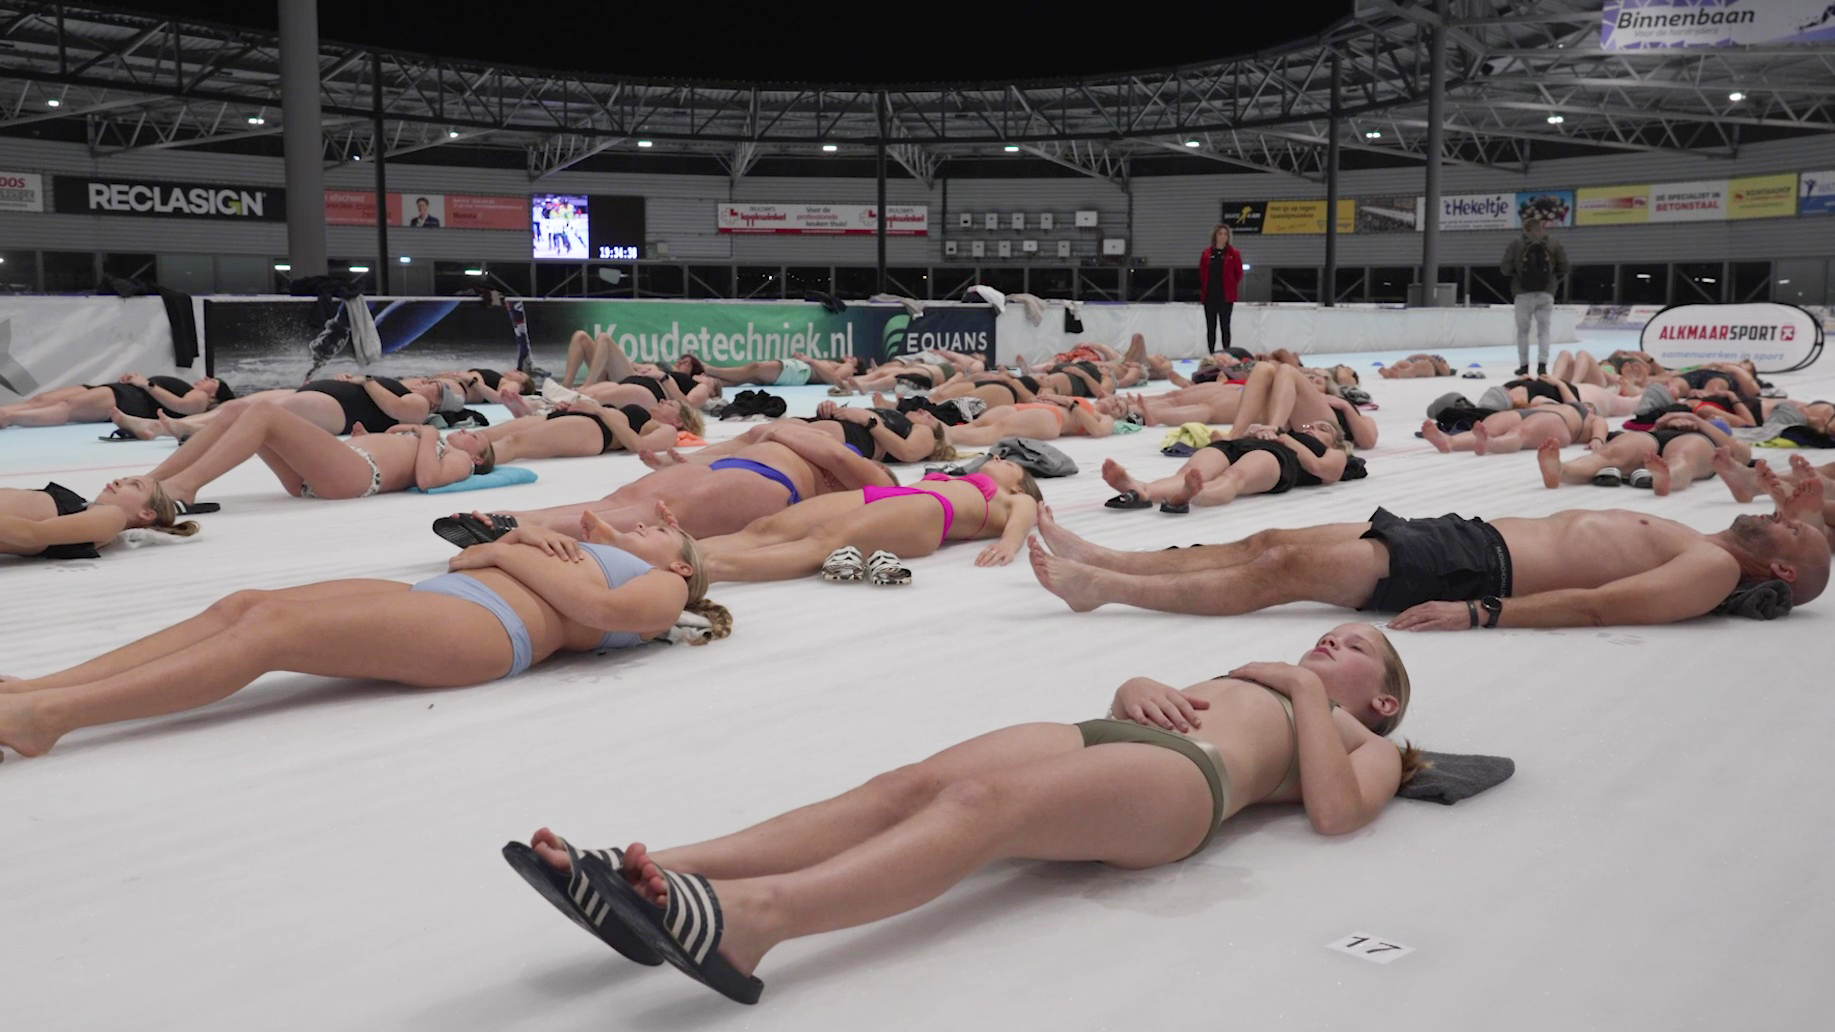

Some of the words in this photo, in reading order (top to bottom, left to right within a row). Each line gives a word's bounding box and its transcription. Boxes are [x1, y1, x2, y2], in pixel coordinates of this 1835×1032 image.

[1617, 8, 1755, 29] Binnenbaan
[88, 183, 264, 216] RECLASIGN
[1452, 197, 1508, 218] Hekeltje
[1656, 201, 1719, 211] BETONSTAAL
[1659, 325, 1777, 340] ALKMAARSPORT
[906, 332, 988, 353] EQUANS
[1661, 351, 1738, 360] samenwerken
[1741, 352, 1750, 360] in
[1753, 352, 1784, 362] sport
[1346, 936, 1401, 954] 17
